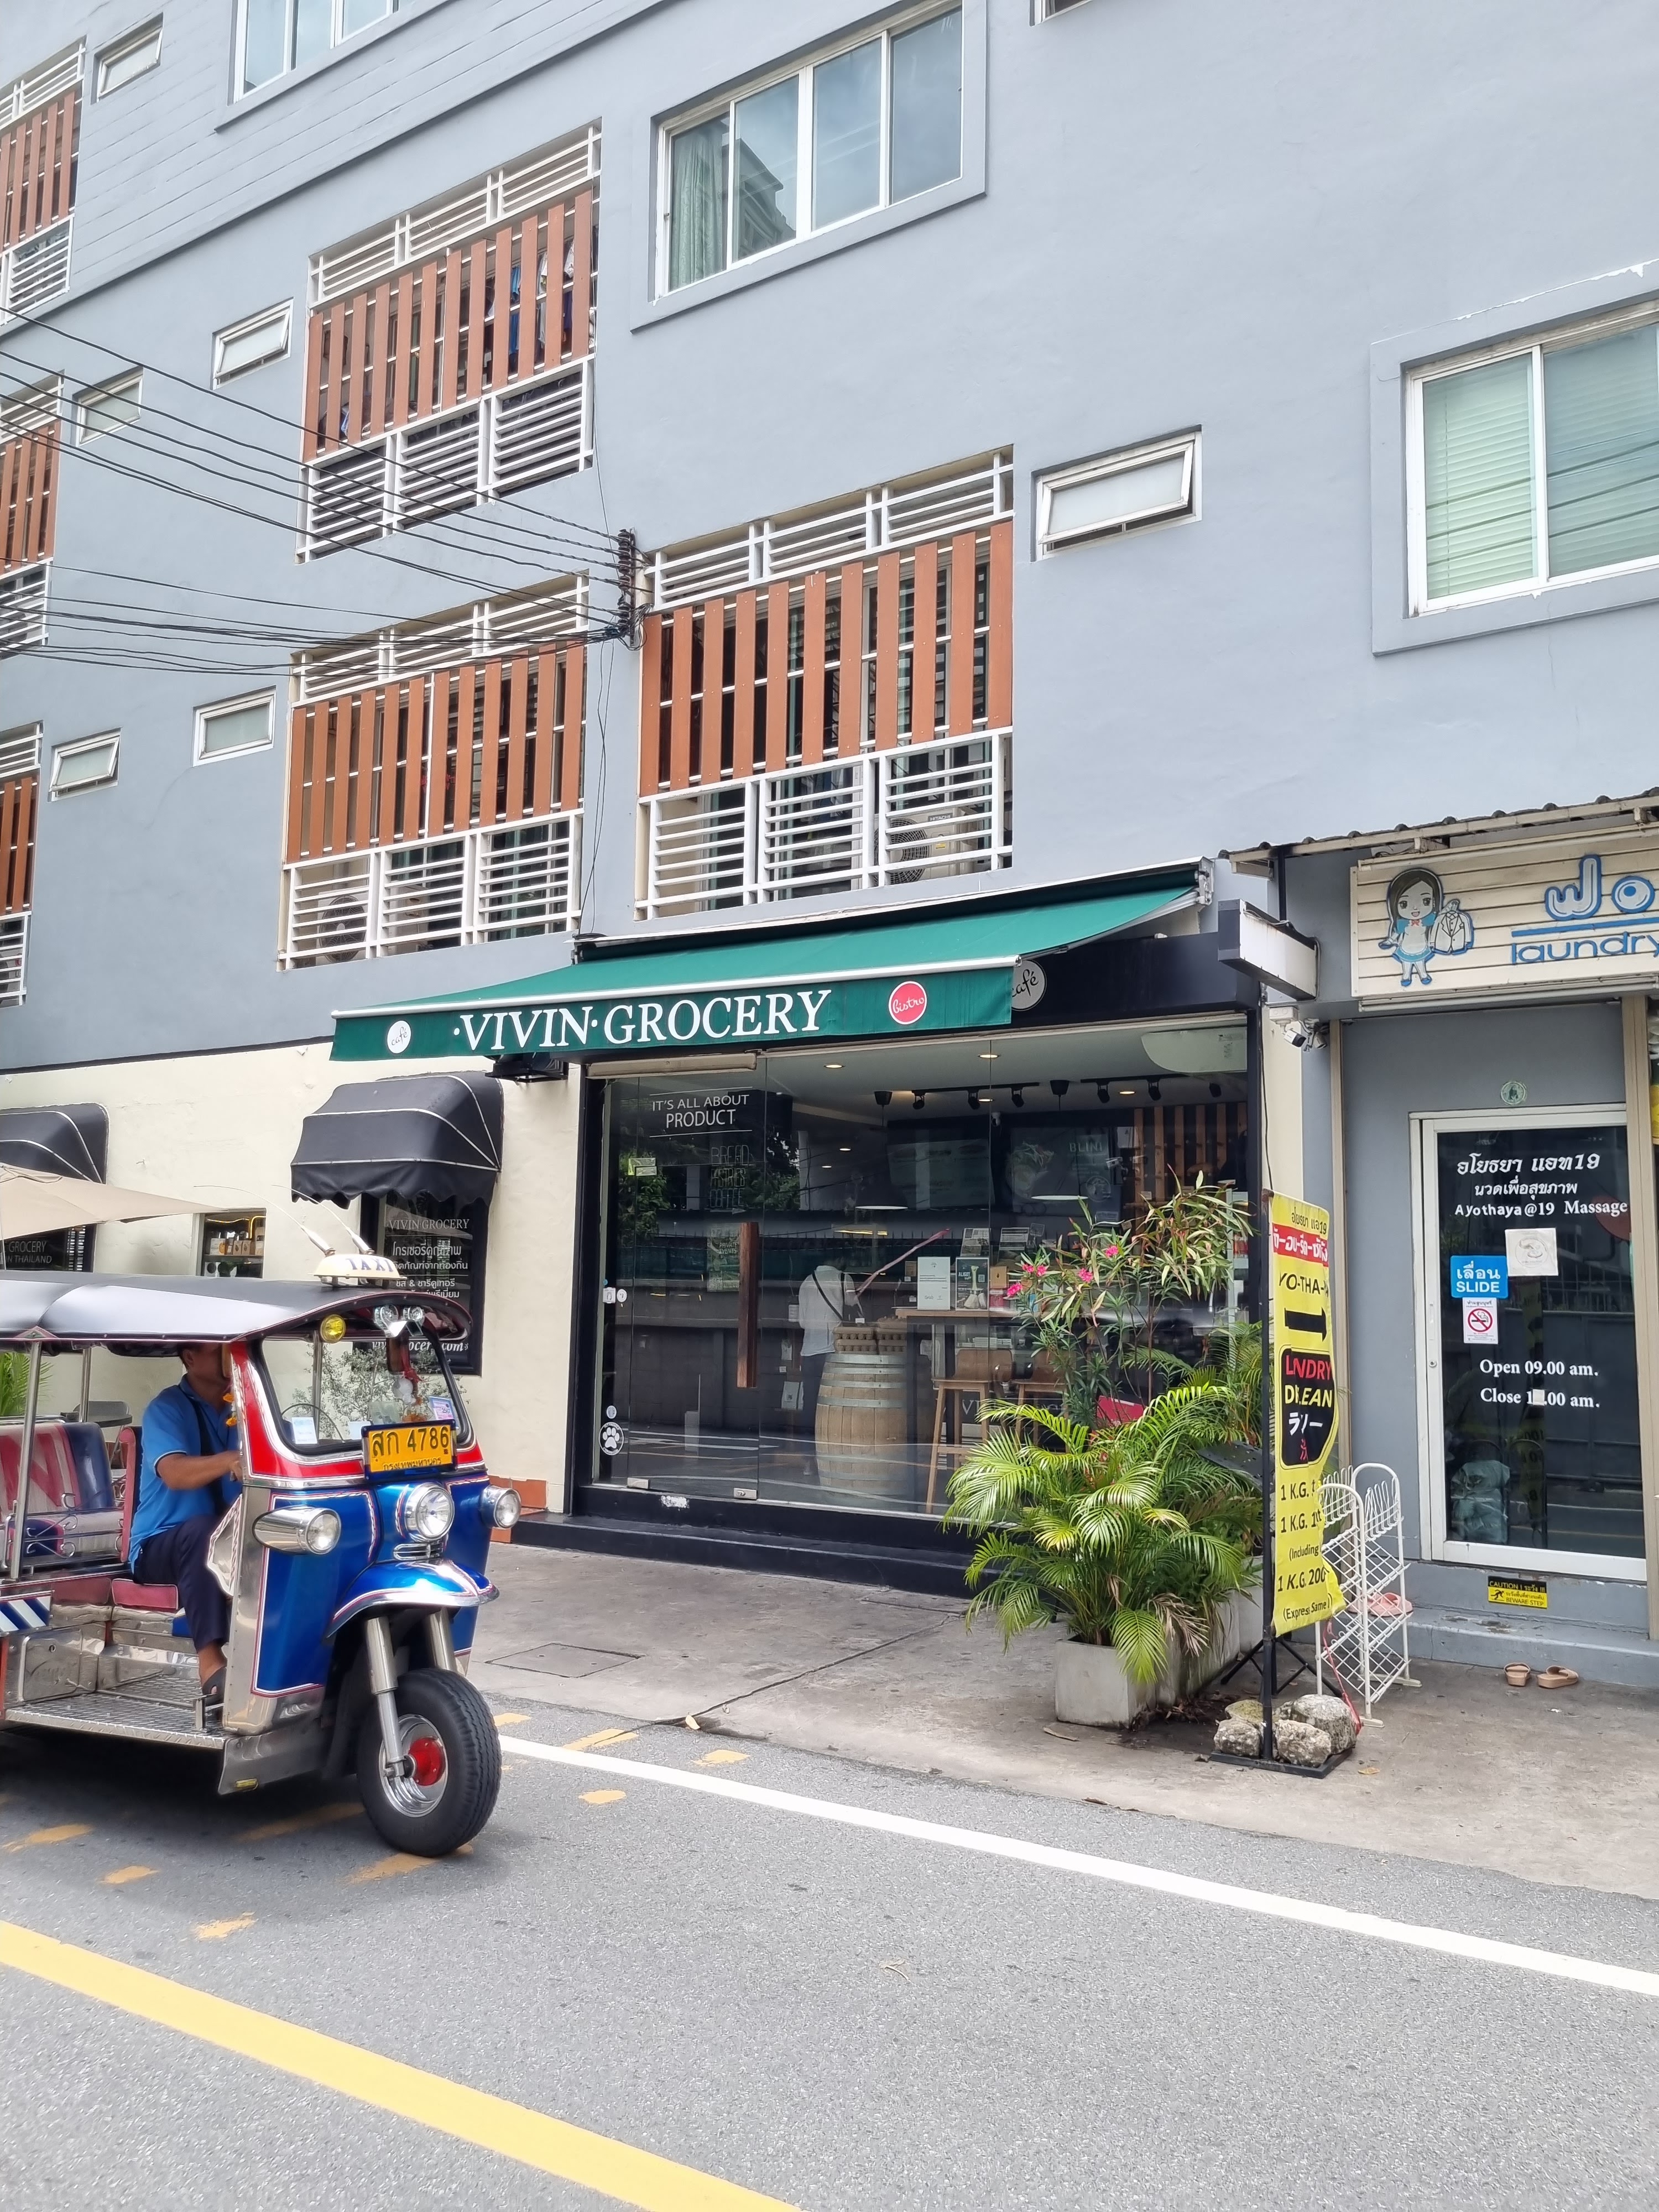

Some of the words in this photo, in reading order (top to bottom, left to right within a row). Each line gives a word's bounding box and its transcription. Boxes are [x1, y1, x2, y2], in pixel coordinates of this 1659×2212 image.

[391, 1026, 408, 1046] café
[652, 1099, 674, 1112] IT'S
[677, 1098, 700, 1109] ALL
[703, 1094, 750, 1108] ABOUT
[666, 1109, 737, 1129] PRODUCT
[1457, 1152, 1523, 1175] อโยธยา
[1531, 1152, 1601, 1172] แอท19
[1474, 1175, 1578, 1201] นวดเพื่อสุขภาพ
[1563, 1199, 1629, 1217] Massage
[8, 1241, 46, 1253] GROCERY
[14, 1255, 53, 1264] THAILAND
[345, 1258, 394, 1272] TAXI
[1457, 1260, 1501, 1280] เลื่อน
[1456, 1281, 1500, 1293] SLIDE
[1479, 1359, 1521, 1378] Open
[1524, 1360, 1565, 1375] 09.00
[1569, 1364, 1599, 1376] am.
[1480, 1387, 1521, 1404] Close
[1526, 1390, 1566, 1406] 1.00
[1570, 1396, 1600, 1408] am.
[407, 1426, 450, 1452] 4786
[1280, 1484, 1286, 1501] 1
[1290, 1482, 1309, 1499] K.G.
[1280, 1516, 1287, 1533] 1
[1290, 1512, 1308, 1532] K.G.
[1277, 1575, 1283, 1592] 1
[1489, 1580, 1519, 1590] CAUTION
[1506, 1597, 1528, 1605] BEWARE
